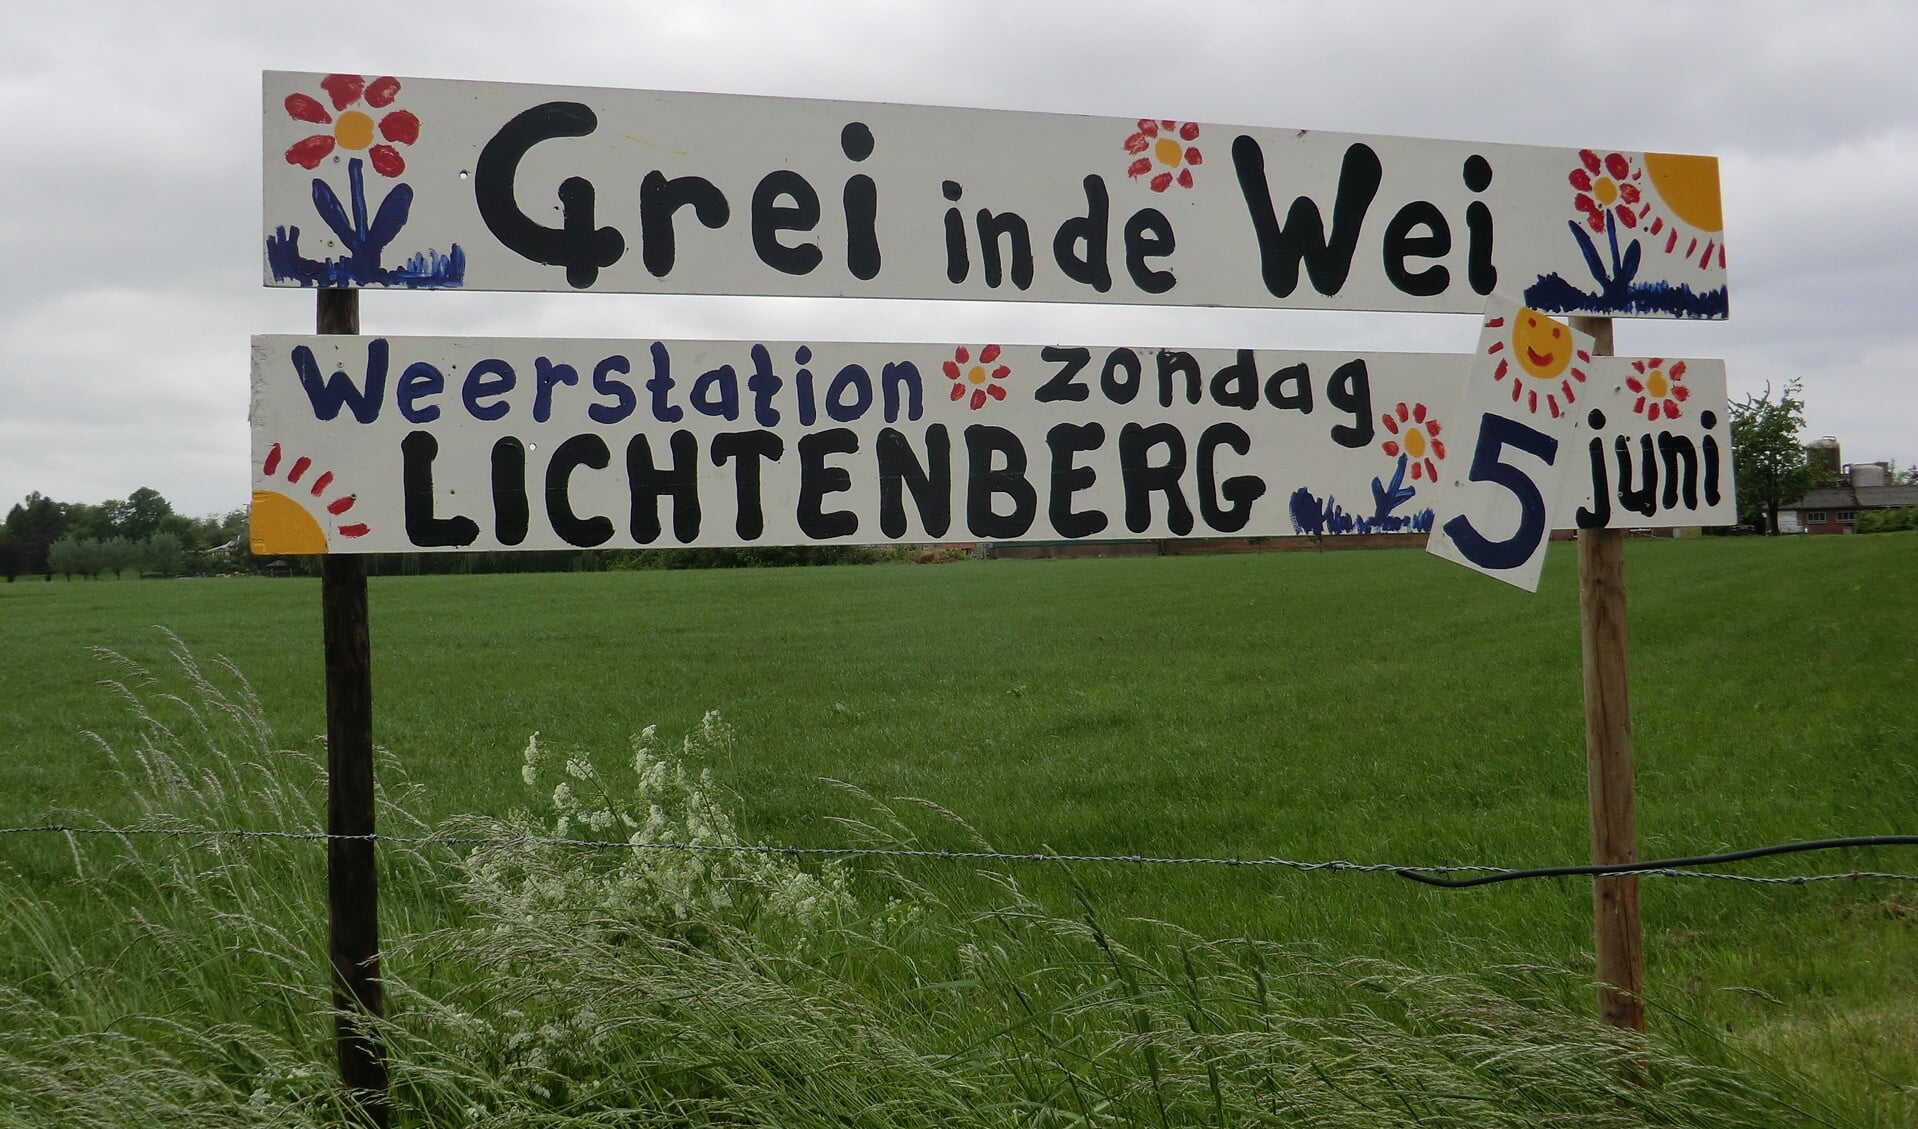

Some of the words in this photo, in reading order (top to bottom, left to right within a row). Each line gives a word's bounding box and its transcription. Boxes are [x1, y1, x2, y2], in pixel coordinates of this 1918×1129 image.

[474, 101, 881, 290] Grei
[1231, 134, 1498, 299] Wei
[290, 337, 924, 426] Weerstation
[1034, 345, 1376, 449] zondag
[400, 421, 1267, 548] LICHTENBERG
[1442, 412, 1560, 570] 5
[1574, 407, 1722, 530] juni
